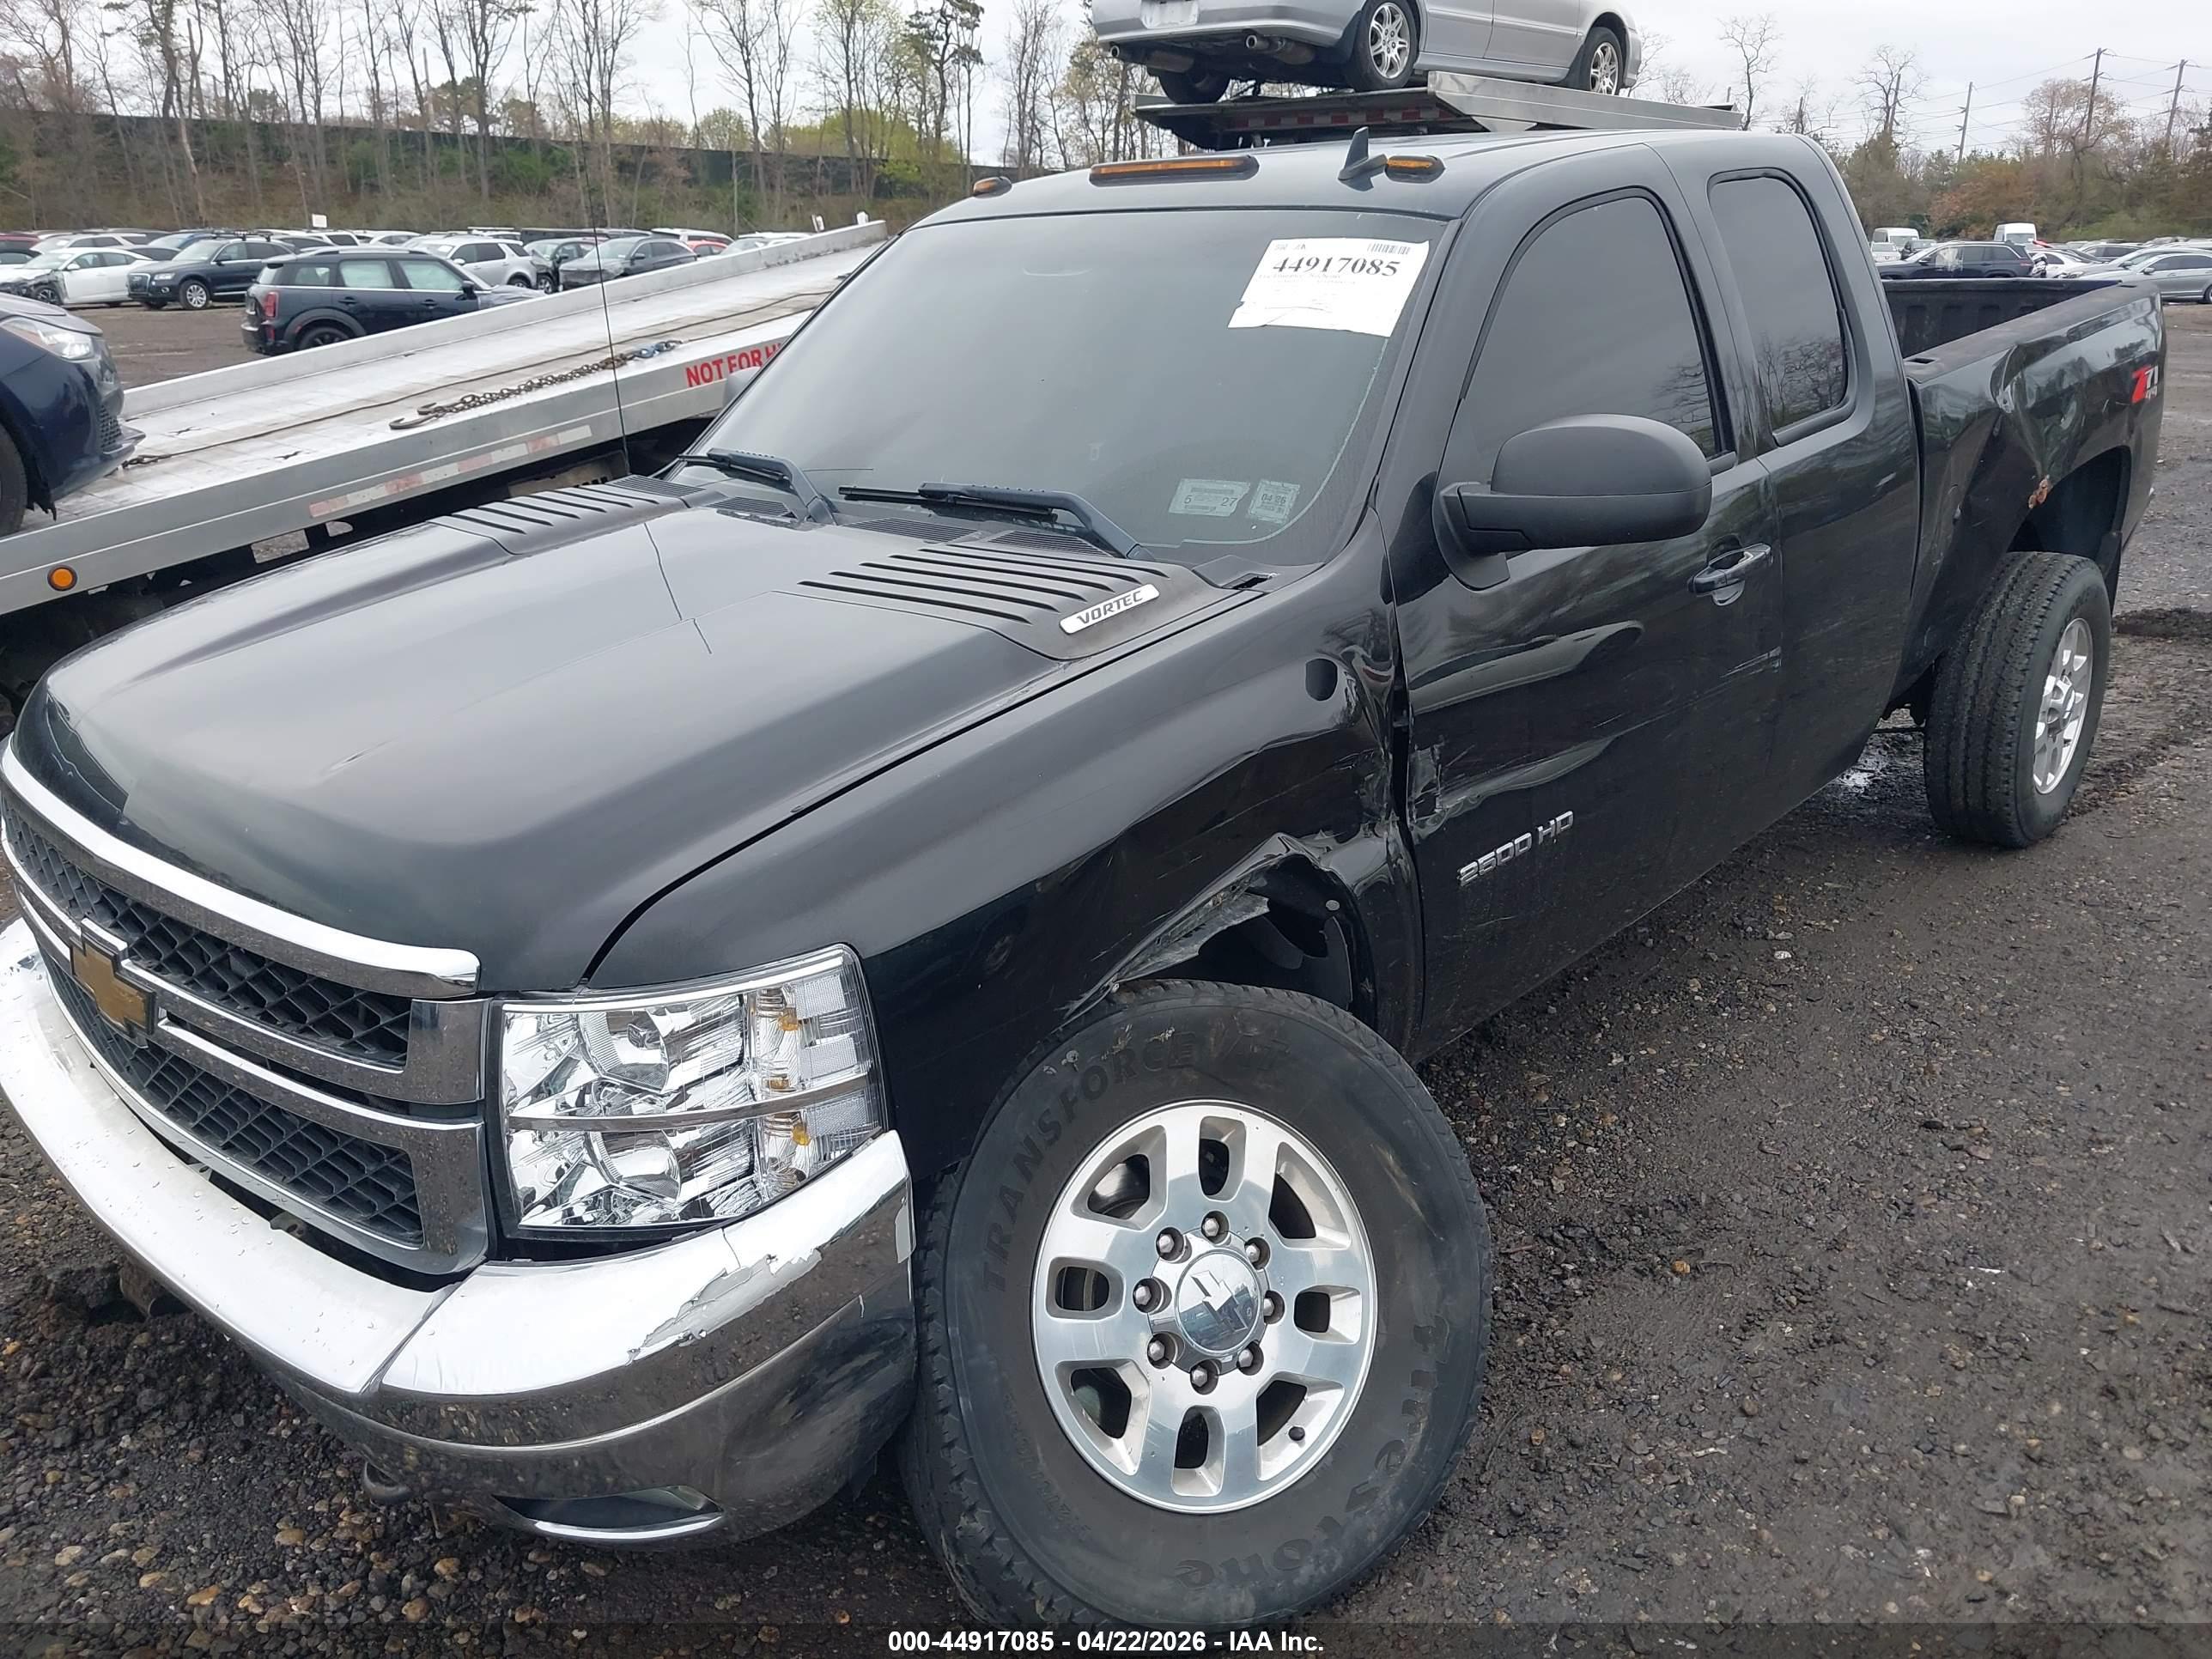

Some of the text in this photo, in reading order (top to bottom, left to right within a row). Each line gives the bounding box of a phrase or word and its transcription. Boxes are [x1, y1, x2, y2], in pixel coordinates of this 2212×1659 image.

[1273, 257, 1400, 276] 44917085
[686, 359, 725, 386] NOT
[727, 348, 763, 373] FOR
[1221, 496, 1238, 507] 27
[1077, 590, 1144, 624] VORTEC
[1536, 810, 1574, 845] HD
